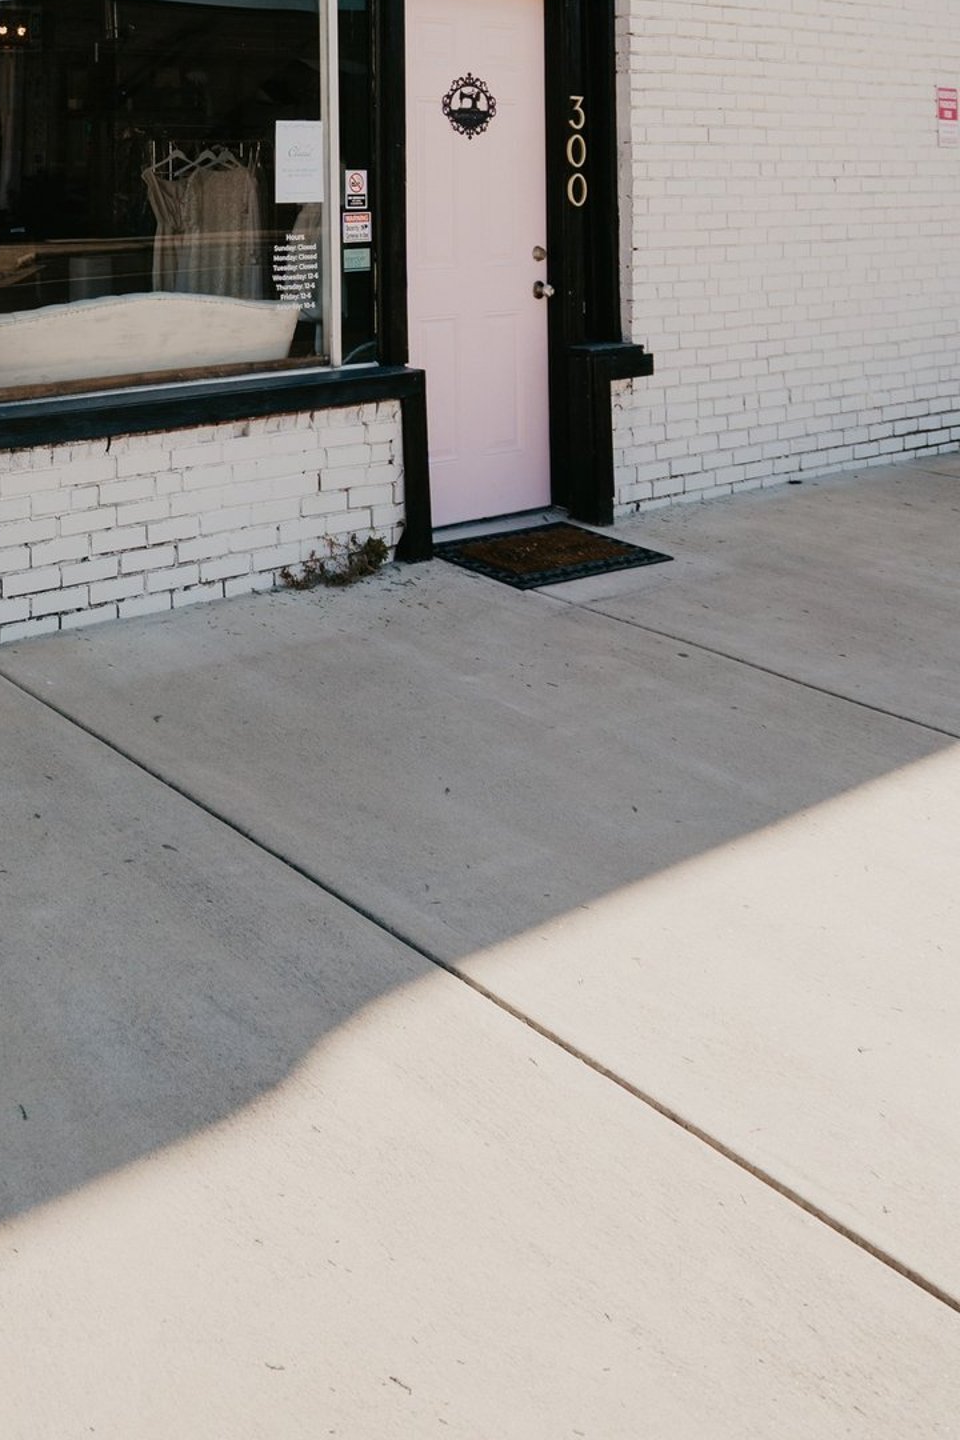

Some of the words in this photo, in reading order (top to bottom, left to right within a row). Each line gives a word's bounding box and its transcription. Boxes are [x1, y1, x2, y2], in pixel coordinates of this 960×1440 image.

[566, 95, 588, 207] 300
[274, 244, 297, 252] Sunday:
[273, 254, 298, 262] Monday:
[272, 264, 298, 272] Tuesday:
[298, 262, 318, 270] Closed
[272, 273, 307, 281] Wednesday:
[276, 283, 303, 291] Thursday:
[280, 293, 300, 301] Friday:
